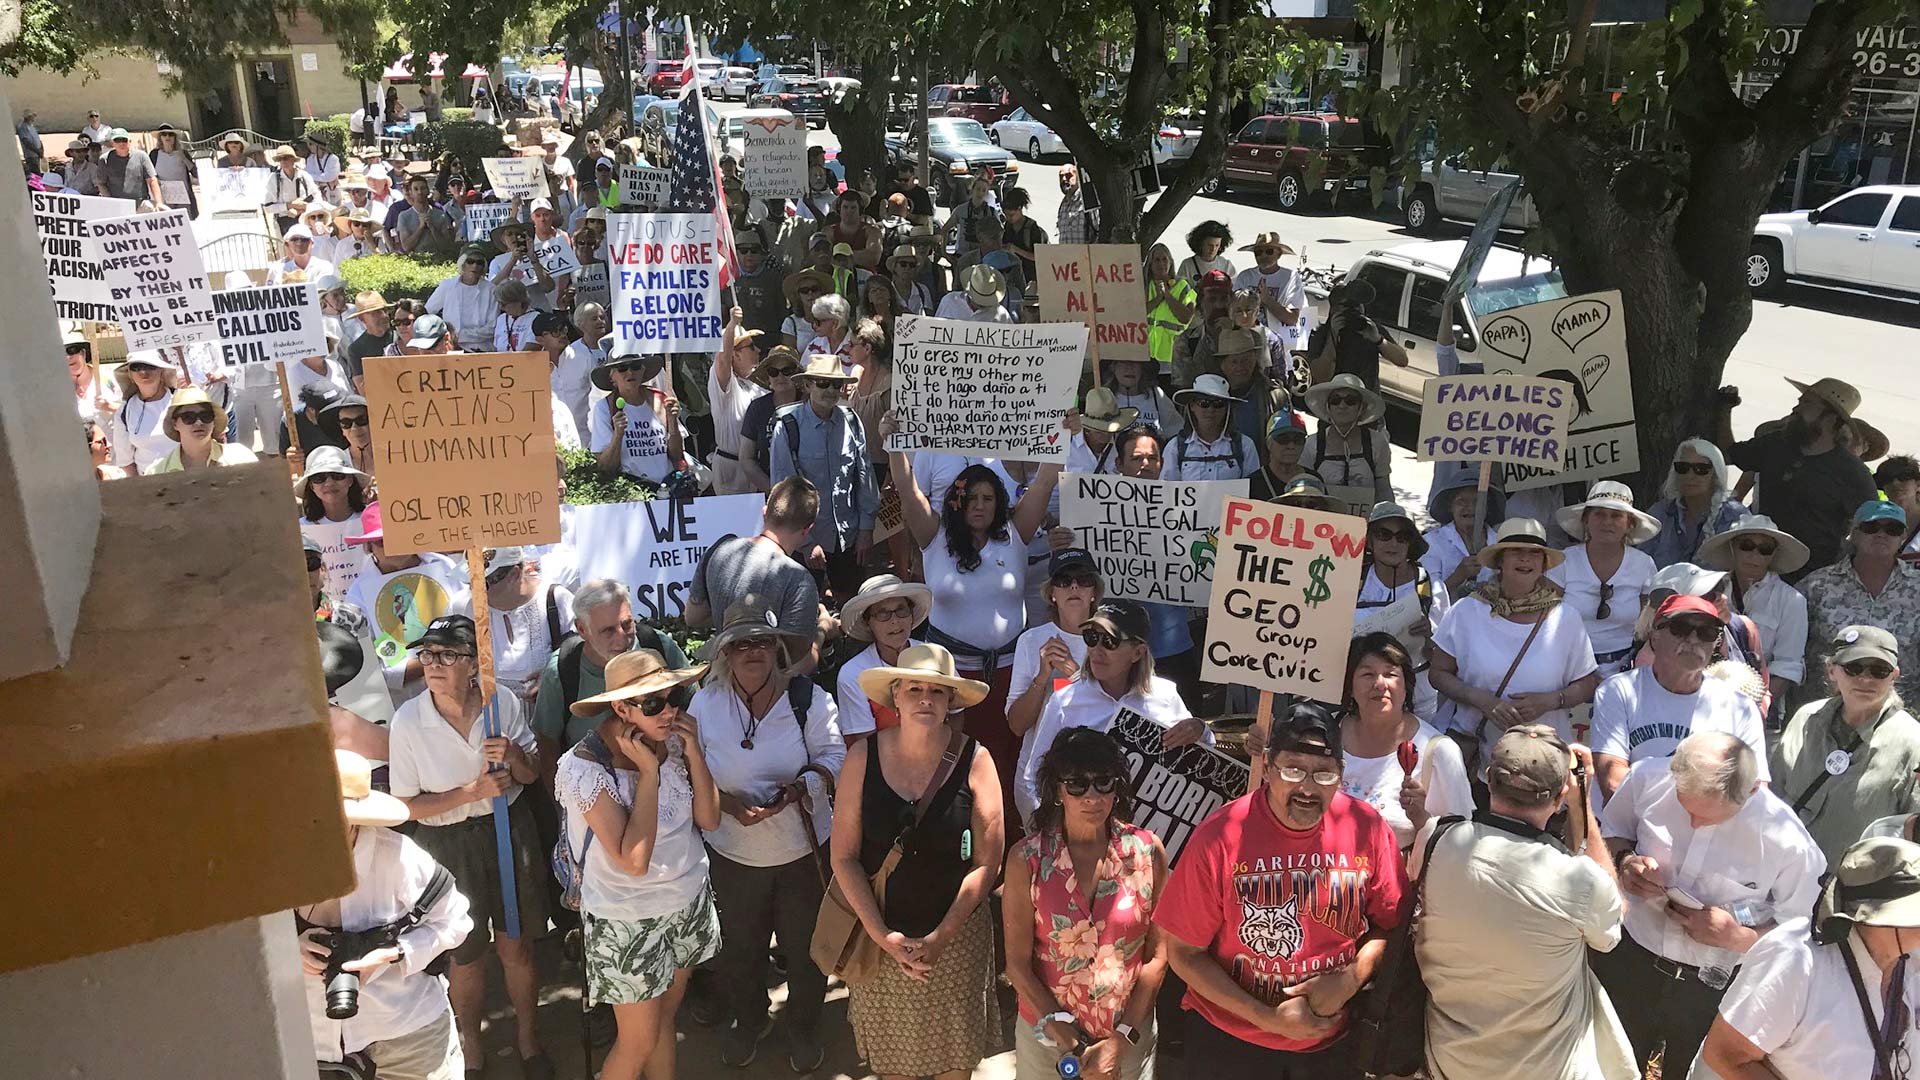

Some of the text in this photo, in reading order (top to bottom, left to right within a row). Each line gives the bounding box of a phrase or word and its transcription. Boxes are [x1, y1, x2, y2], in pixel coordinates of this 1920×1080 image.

[622, 168, 669, 182] ARIZONA
[629, 180, 661, 193] HAS A
[630, 191, 659, 203] SOUL
[34, 194, 80, 215] STOP
[493, 208, 513, 218] ADOP
[35, 215, 89, 237] PRETE
[93, 215, 183, 237] DON'T WAIT
[104, 234, 181, 254] UNTIL IT
[610, 243, 712, 264] WE DO CARE
[47, 258, 105, 280] ACISM
[102, 251, 173, 271] AFFECTS
[134, 269, 170, 282] YOU
[620, 269, 709, 290] FAMILIES
[1051, 262, 1135, 283] WE ARE
[111, 278, 203, 300] BY THEN IT
[212, 285, 308, 314] INHUMANE
[120, 297, 189, 318] WILL BE
[631, 293, 705, 315] BELONG
[1066, 290, 1105, 313] ALL
[128, 310, 215, 332] TOO LATE
[217, 310, 302, 338] CALLOUS
[616, 316, 722, 340] TOGETHER
[1556, 307, 1601, 335] MAMA
[928, 326, 954, 343] IN
[965, 327, 1034, 347] LAK'ECH
[1036, 337, 1058, 346] MAYA
[1095, 322, 1149, 345] RANTS
[222, 341, 270, 366] EVIL
[924, 349, 959, 364] eres
[964, 352, 982, 365] mi
[987, 351, 1020, 367] otro
[1049, 344, 1077, 353] WISDOM
[396, 365, 515, 393] CRIMES
[895, 358, 1044, 382] You are my other me
[923, 377, 940, 393] te
[946, 378, 976, 397] hago
[983, 381, 1015, 396] daño
[1020, 386, 1031, 394] a
[1035, 383, 1047, 394] ti
[1437, 383, 1563, 408] FAMILIES
[381, 389, 545, 429] AGAINST
[912, 391, 922, 407] I
[927, 393, 942, 408] do
[949, 394, 985, 409] harm
[990, 397, 1007, 409] to
[1011, 399, 1036, 415] you
[634, 421, 650, 430] NO
[895, 406, 1067, 427] ME hago daño a mi mism
[1447, 411, 1555, 435] BELONG
[625, 429, 664, 439] HUMAN
[907, 421, 928, 433] DO
[933, 423, 975, 436] HARM
[977, 424, 994, 436] TO
[999, 422, 1056, 436] MYSELF
[387, 433, 533, 464] HUMANITY
[626, 440, 656, 448] BEING
[629, 446, 668, 457] ILLEGAL
[1027, 445, 1063, 456] MYSELF
[1424, 436, 1559, 462] TOGETHER
[1582, 439, 1620, 469] ICE
[1079, 477, 1196, 507] NO ONE IS
[438, 495, 472, 520] FOR
[480, 490, 543, 516] TRUMP
[438, 526, 472, 543] THE
[481, 519, 539, 539] HAGUE
[644, 497, 698, 543] WE
[1225, 502, 1366, 558] FOLLOW
[1074, 526, 1186, 557] THERE IS
[650, 549, 681, 568] ARE
[1098, 557, 1213, 583] OUGH FOR
[1234, 543, 1335, 609] THE $
[1110, 577, 1195, 603] US ALL
[1224, 588, 1300, 629] GEO
[1256, 626, 1317, 654] Group
[1255, 853, 1348, 872] ARIZONA
